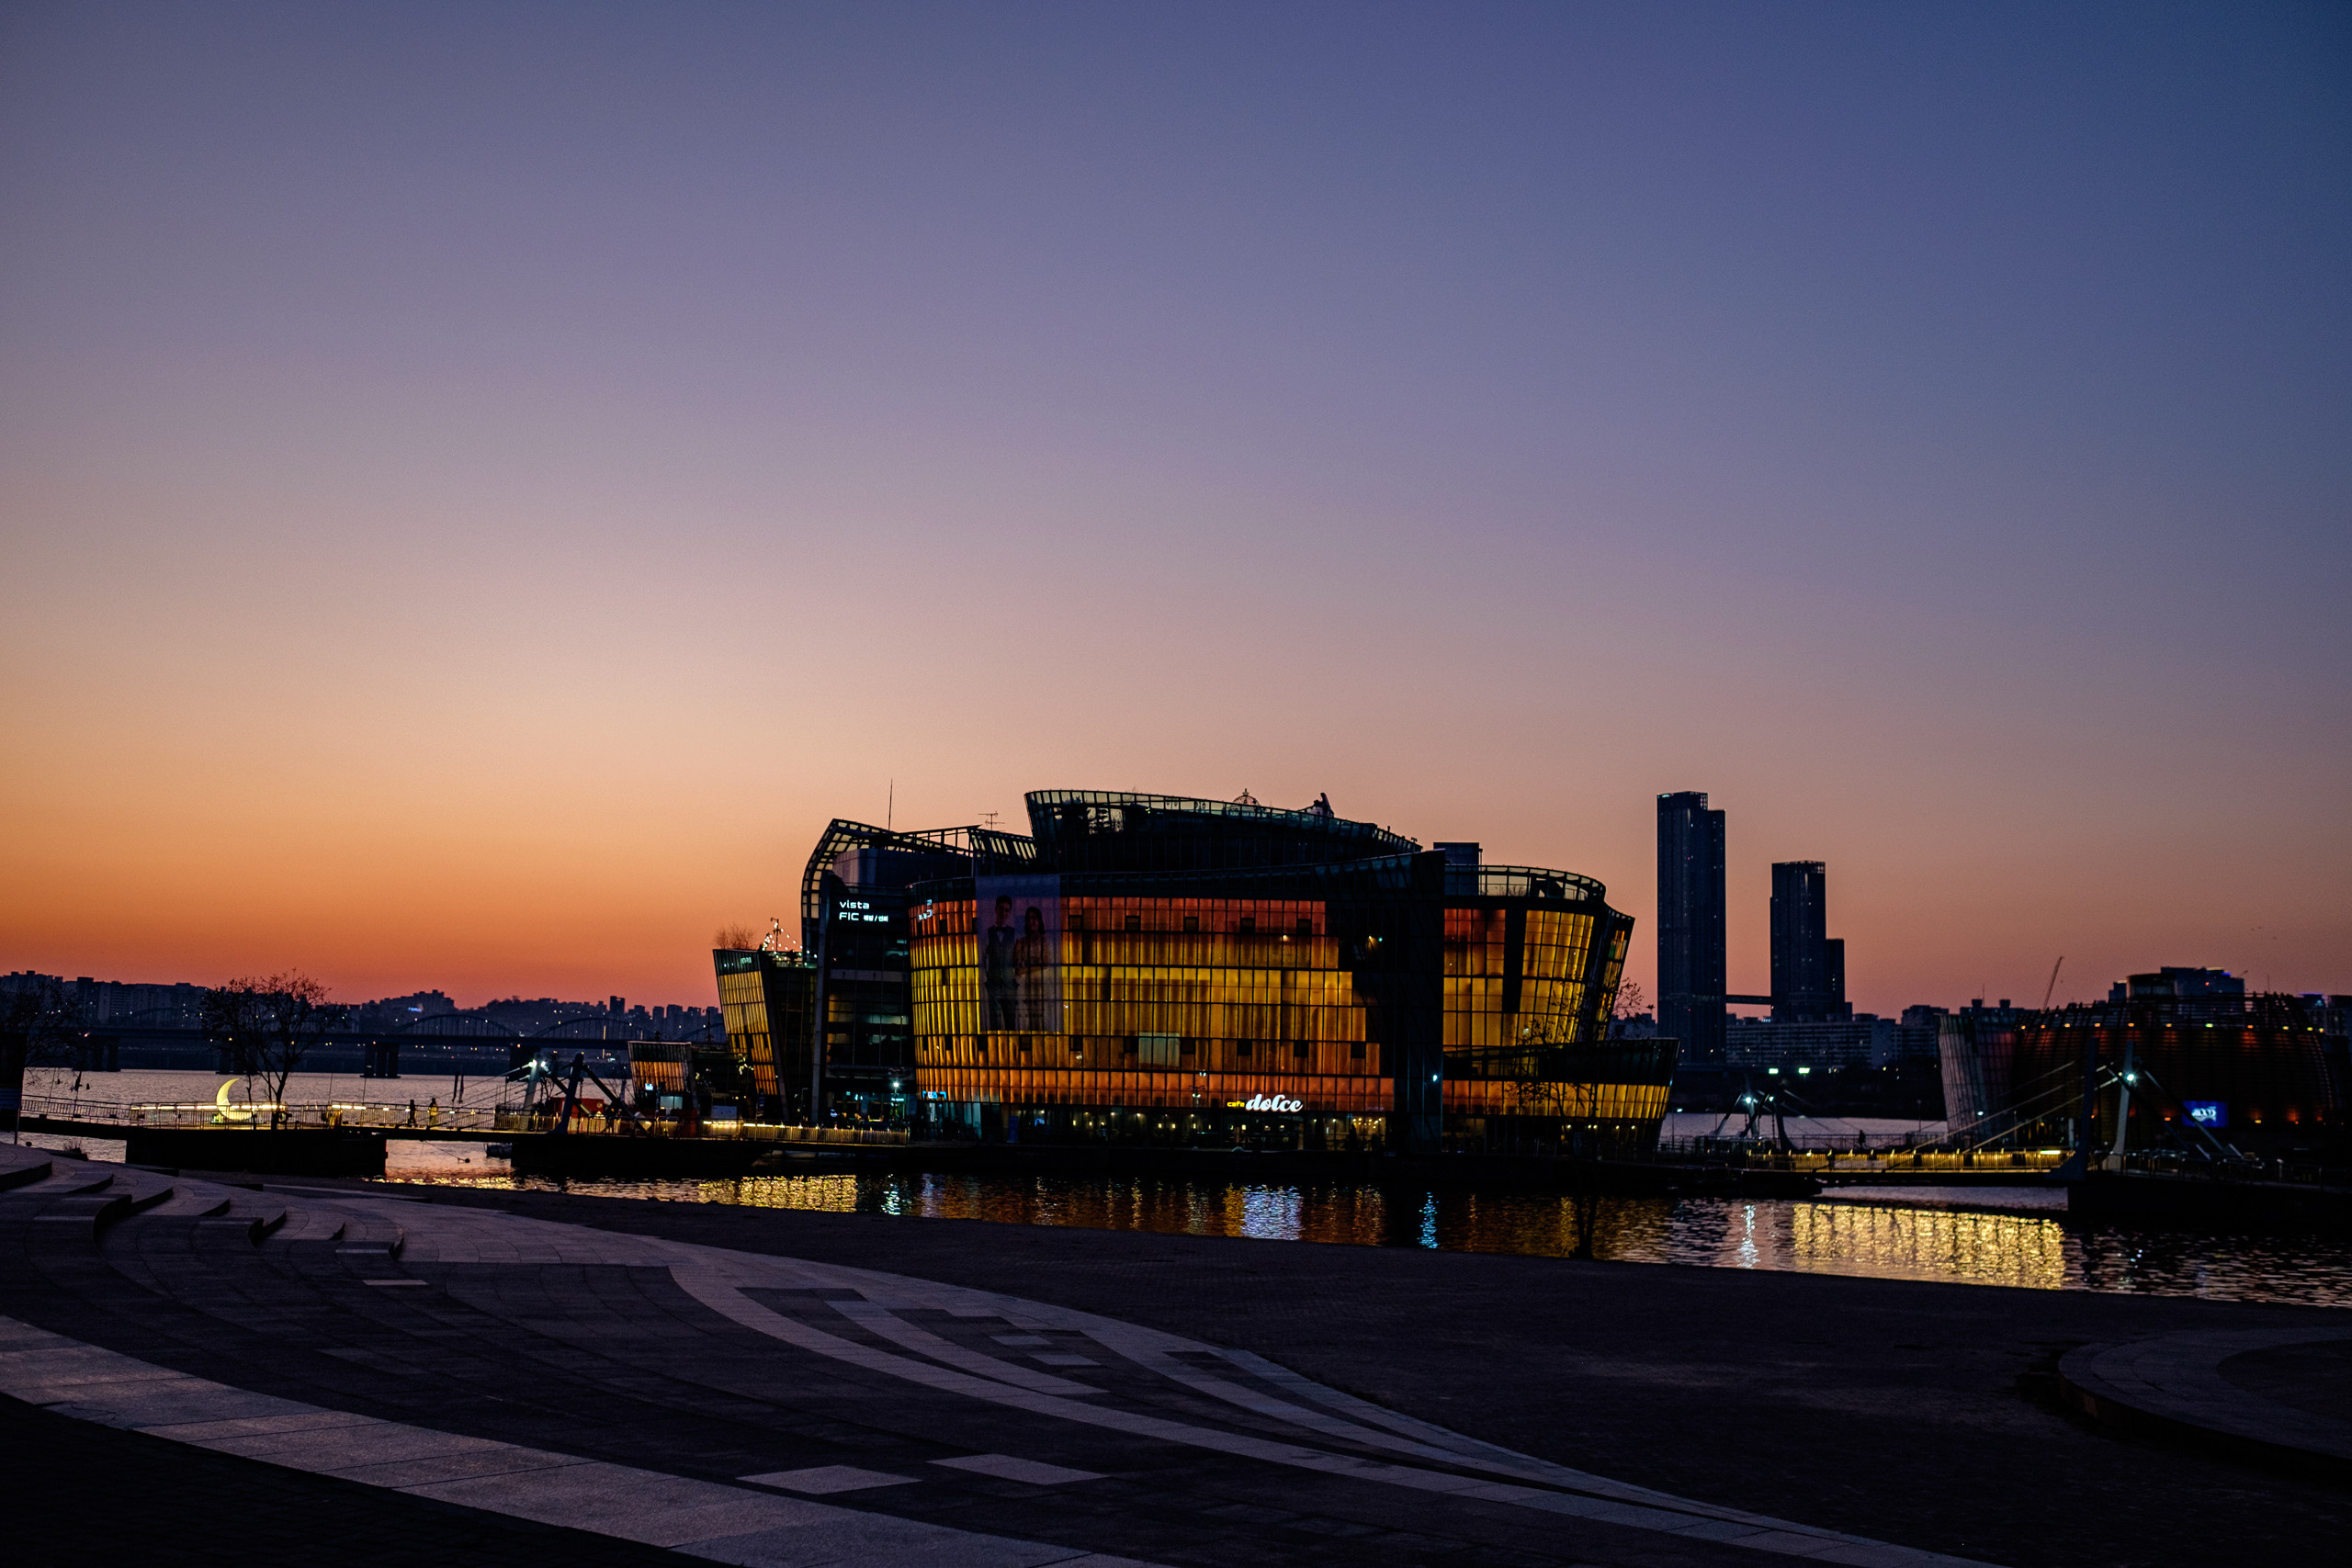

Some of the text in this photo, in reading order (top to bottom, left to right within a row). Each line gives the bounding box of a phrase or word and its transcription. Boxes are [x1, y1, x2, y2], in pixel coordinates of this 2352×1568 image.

[839, 899, 870, 909] vista
[839, 912, 860, 921] FIC
[1245, 1093, 1304, 1112] dolce
